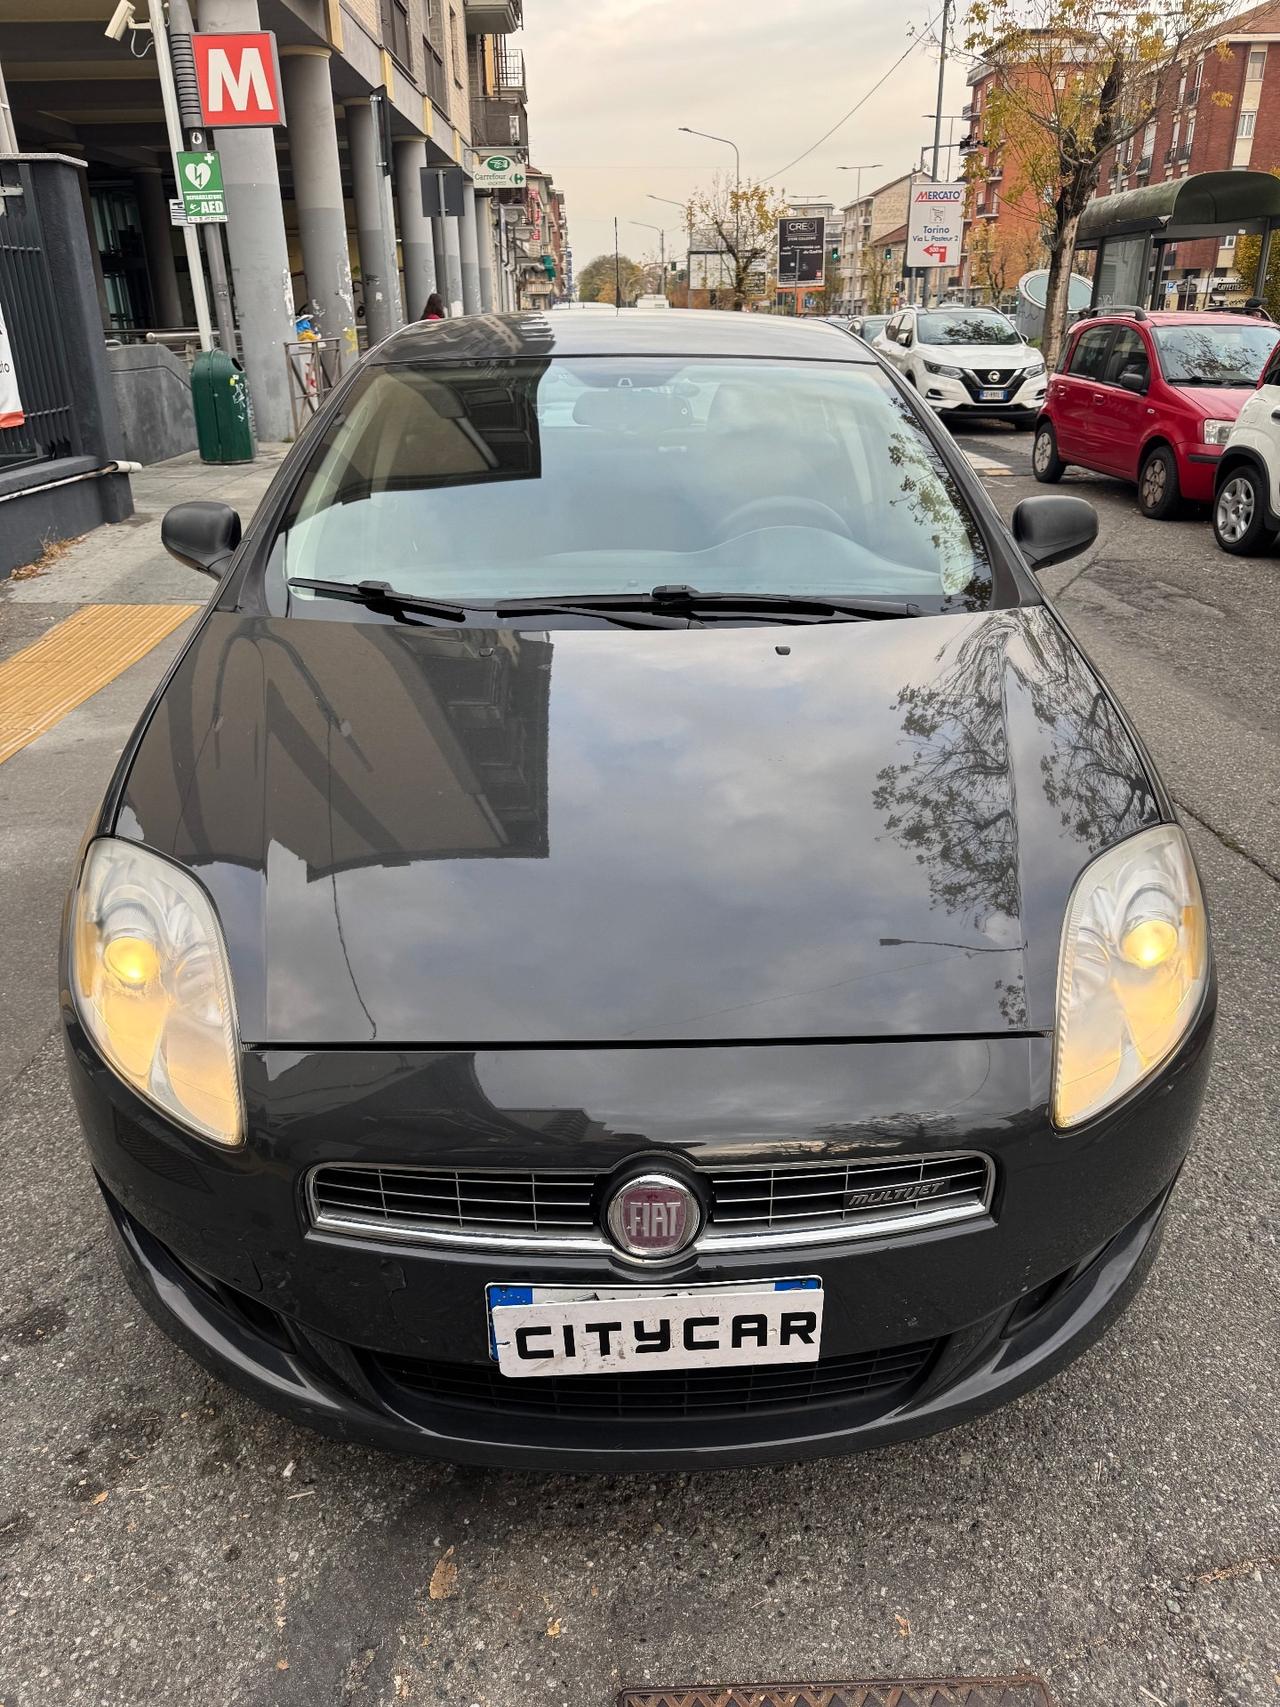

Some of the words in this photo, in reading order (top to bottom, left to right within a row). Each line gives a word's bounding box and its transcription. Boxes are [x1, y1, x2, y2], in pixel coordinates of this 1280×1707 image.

[208, 48, 274, 111] M
[201, 201, 224, 213] AED
[789, 221, 815, 231] CREO
[848, 1182, 945, 1205] MULTIJET
[630, 1202, 681, 1237] FIAT
[515, 1311, 817, 1360] CITYCAR
